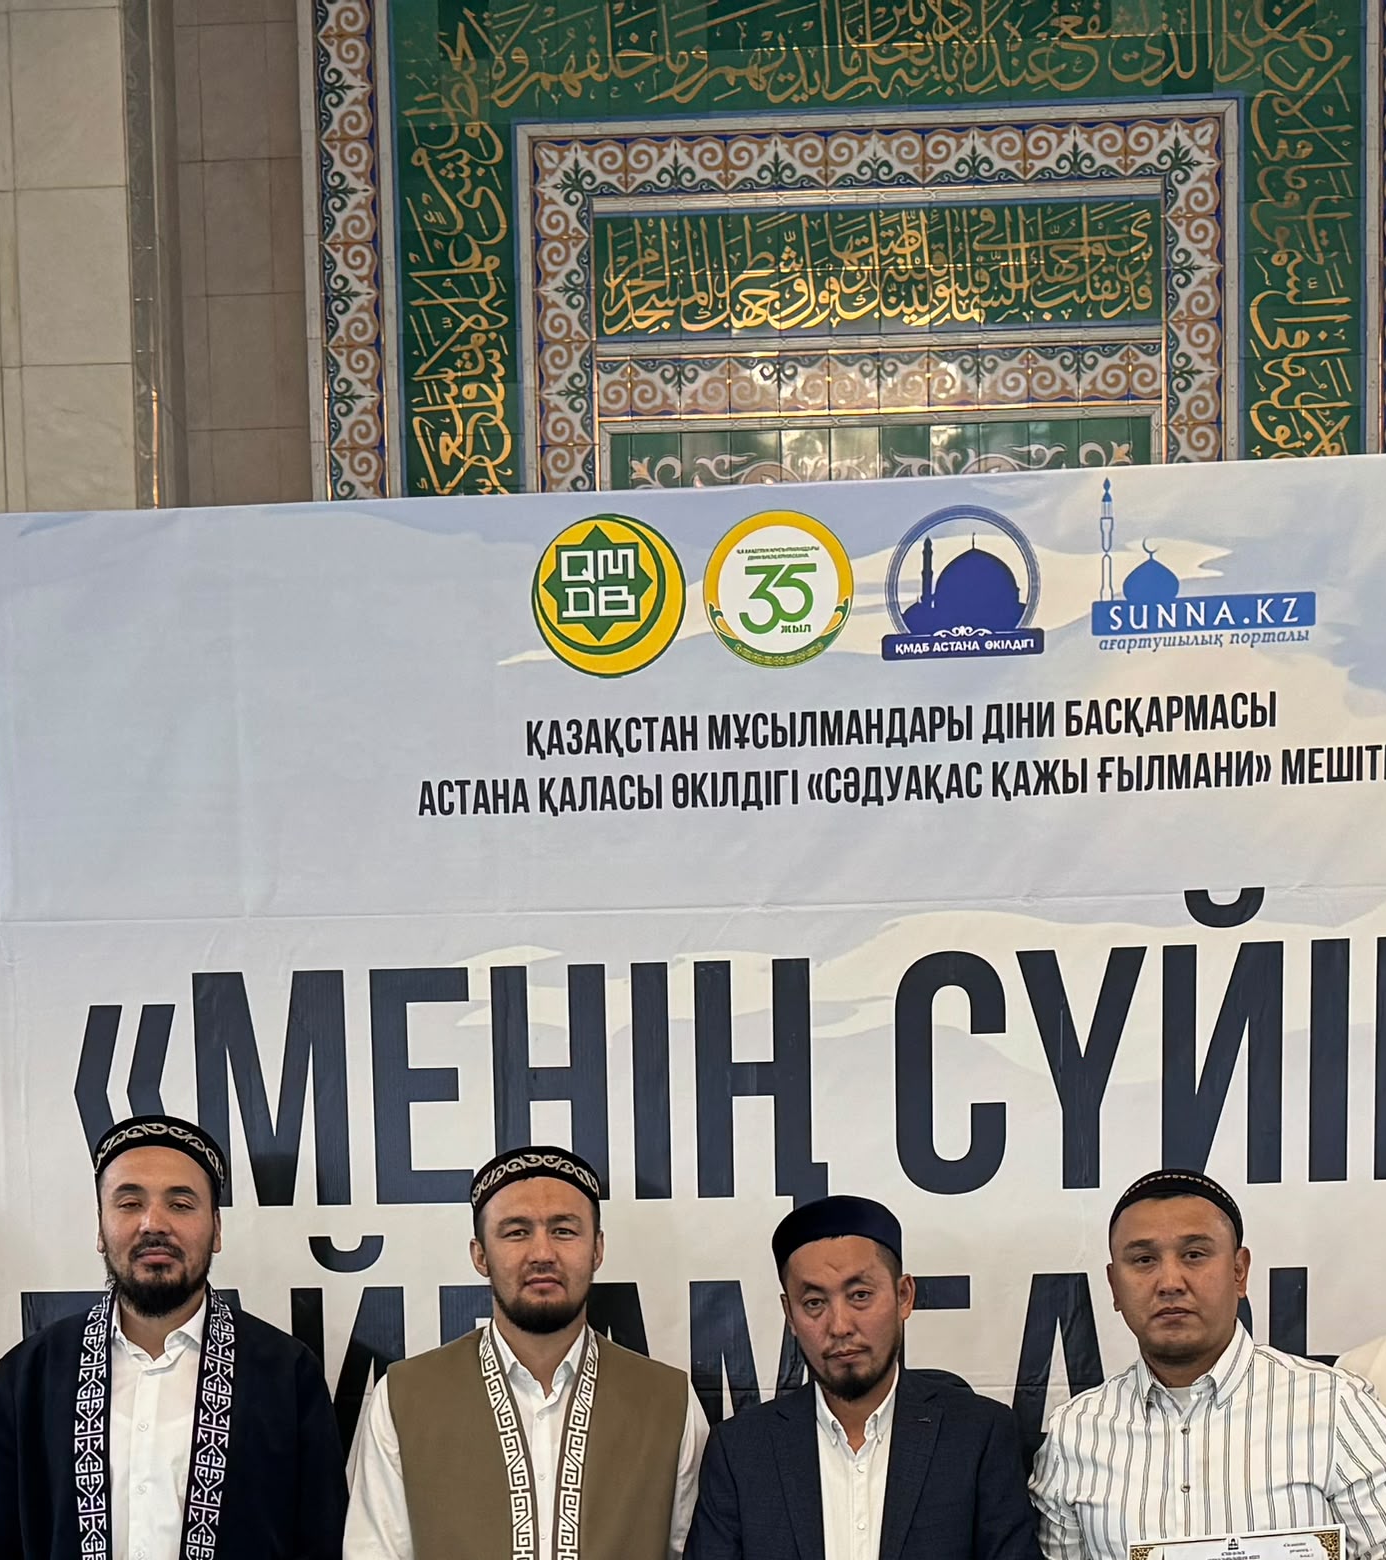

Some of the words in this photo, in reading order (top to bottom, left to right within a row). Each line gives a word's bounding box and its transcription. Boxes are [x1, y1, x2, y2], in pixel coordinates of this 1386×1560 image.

[739, 562, 817, 635] 35
[1108, 597, 1301, 632] SUNNA.KZ
[894, 642, 932, 656] ҚМДБ
[932, 640, 981, 653] АСТАНА
[984, 637, 1035, 652] ӨКІЛДІГІ
[1099, 631, 1225, 654] ағартушылық
[1229, 628, 1311, 650] порталы
[526, 715, 697, 760] ҚАЗАҚСТАН
[708, 706, 973, 750] МҰСЫЛМАНДАРЫ
[983, 702, 1055, 745] ДІНИ
[1066, 692, 1276, 738] БАСҚАРМАСЫ
[418, 776, 530, 817] АСТАНА
[539, 773, 663, 822] ҚАЛАСЫ
[673, 769, 799, 813] ӨКІЛДІГІ
[807, 758, 986, 811] «СӘДУАҚАС
[991, 756, 1089, 803] ҚАЖЫ
[1097, 752, 1272, 794] ҒЫЛМАНИ»
[74, 957, 829, 1207] «МЕНІҢ
